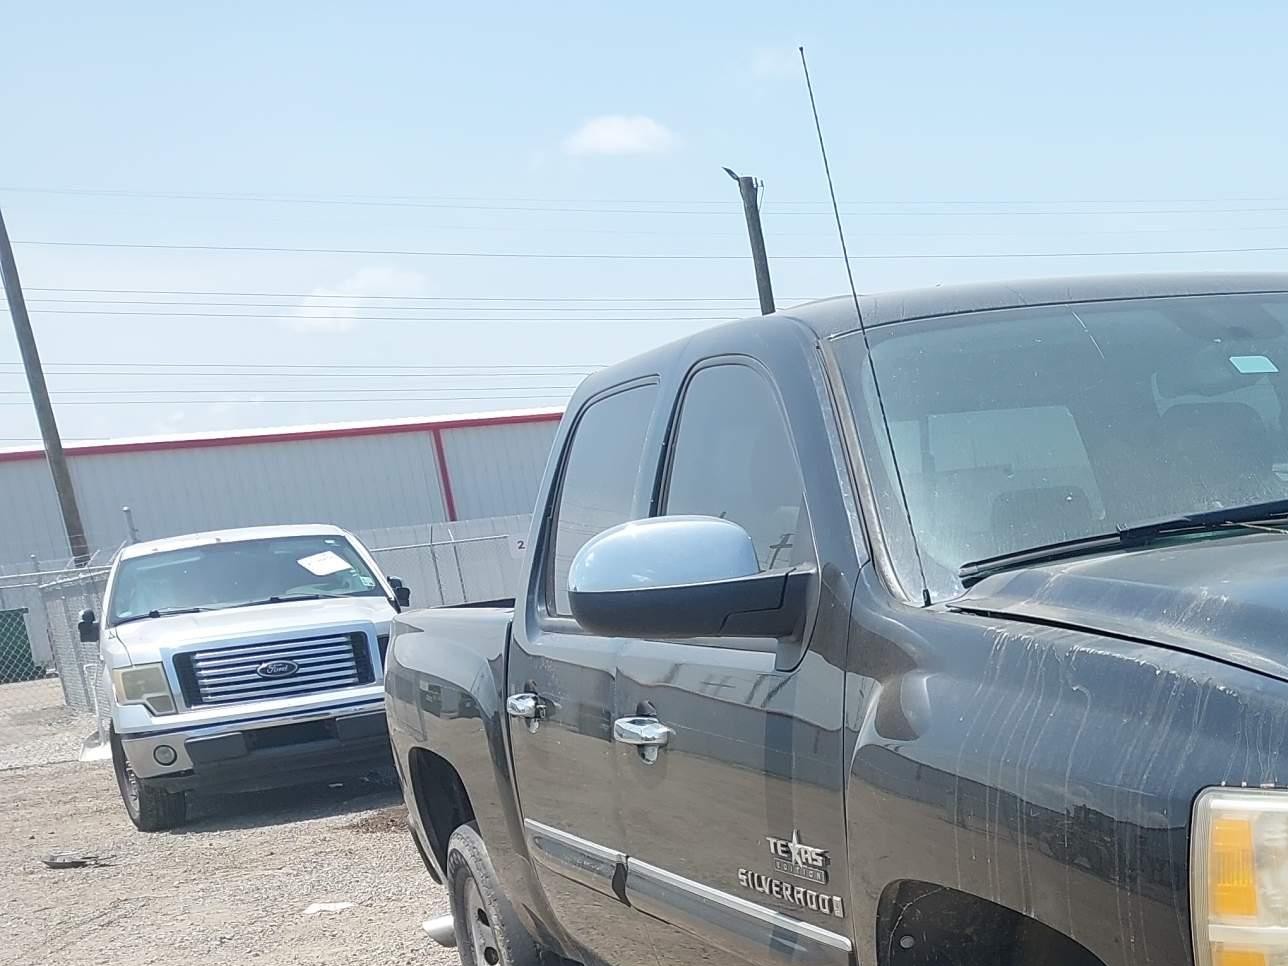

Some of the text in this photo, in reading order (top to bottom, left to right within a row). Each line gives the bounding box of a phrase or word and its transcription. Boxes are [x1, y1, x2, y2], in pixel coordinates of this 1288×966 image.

[517, 540, 526, 550] 2
[766, 829, 829, 867] TEXAS
[775, 860, 824, 882] EDITION
[738, 868, 831, 915] SILVERADO
